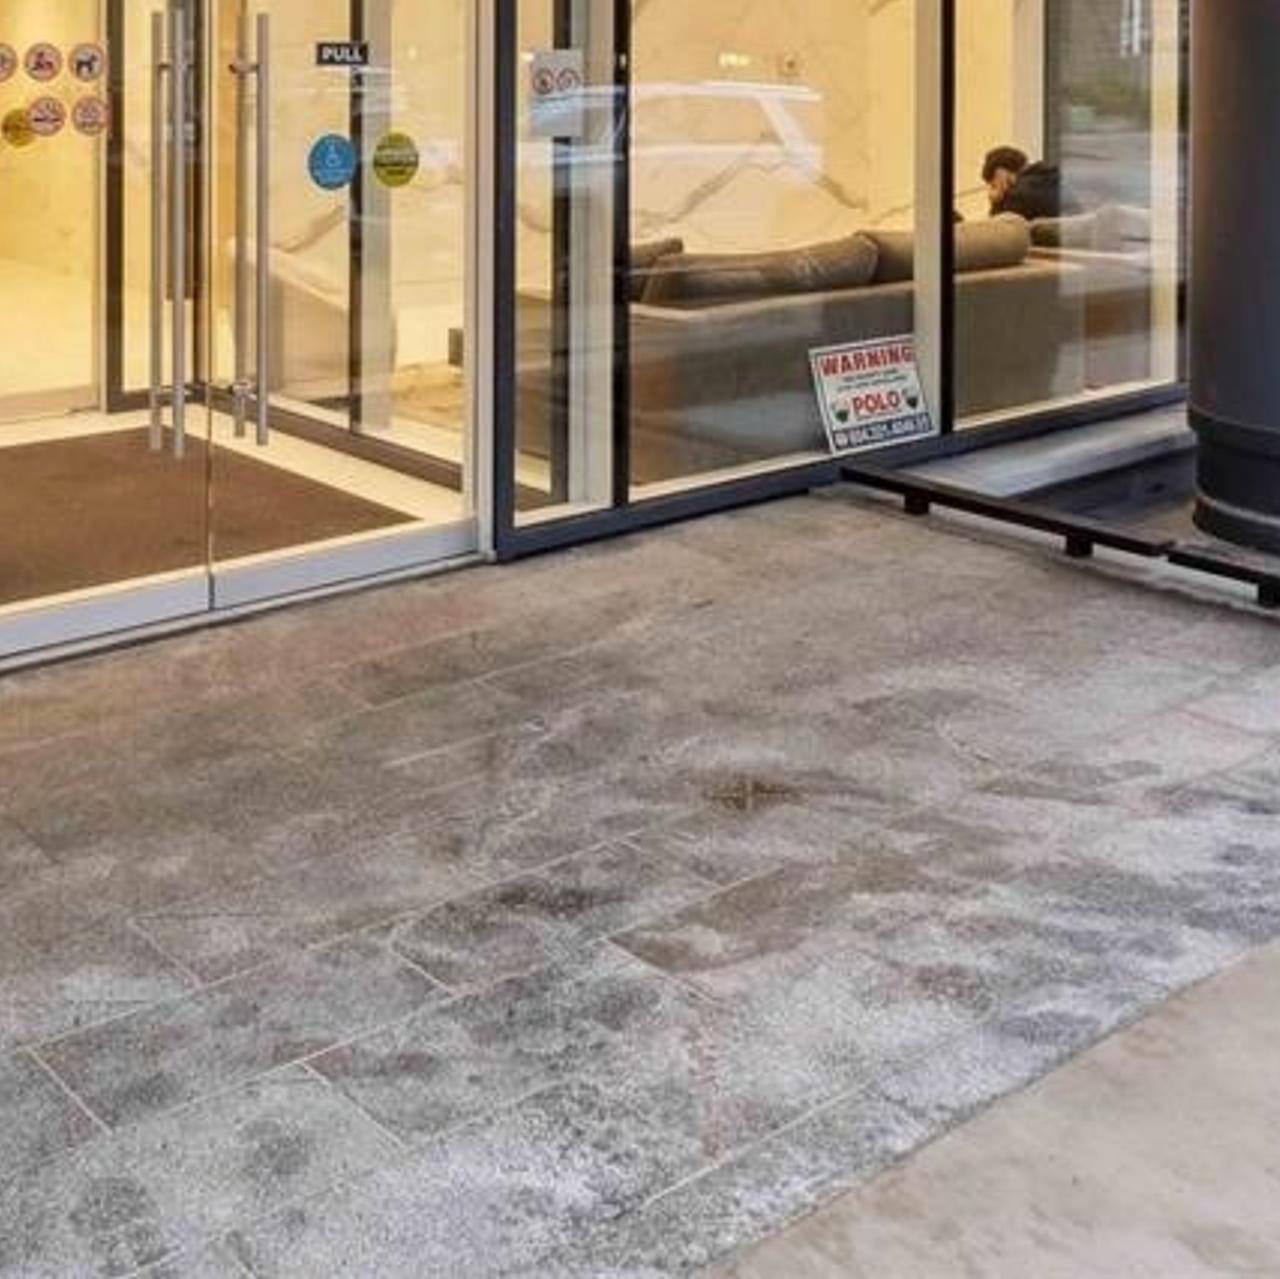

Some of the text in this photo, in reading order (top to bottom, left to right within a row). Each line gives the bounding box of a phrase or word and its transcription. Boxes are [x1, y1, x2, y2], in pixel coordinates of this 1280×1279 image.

[322, 46, 363, 62] PULL
[822, 346, 914, 377] WARNING
[852, 391, 900, 415] POLO
